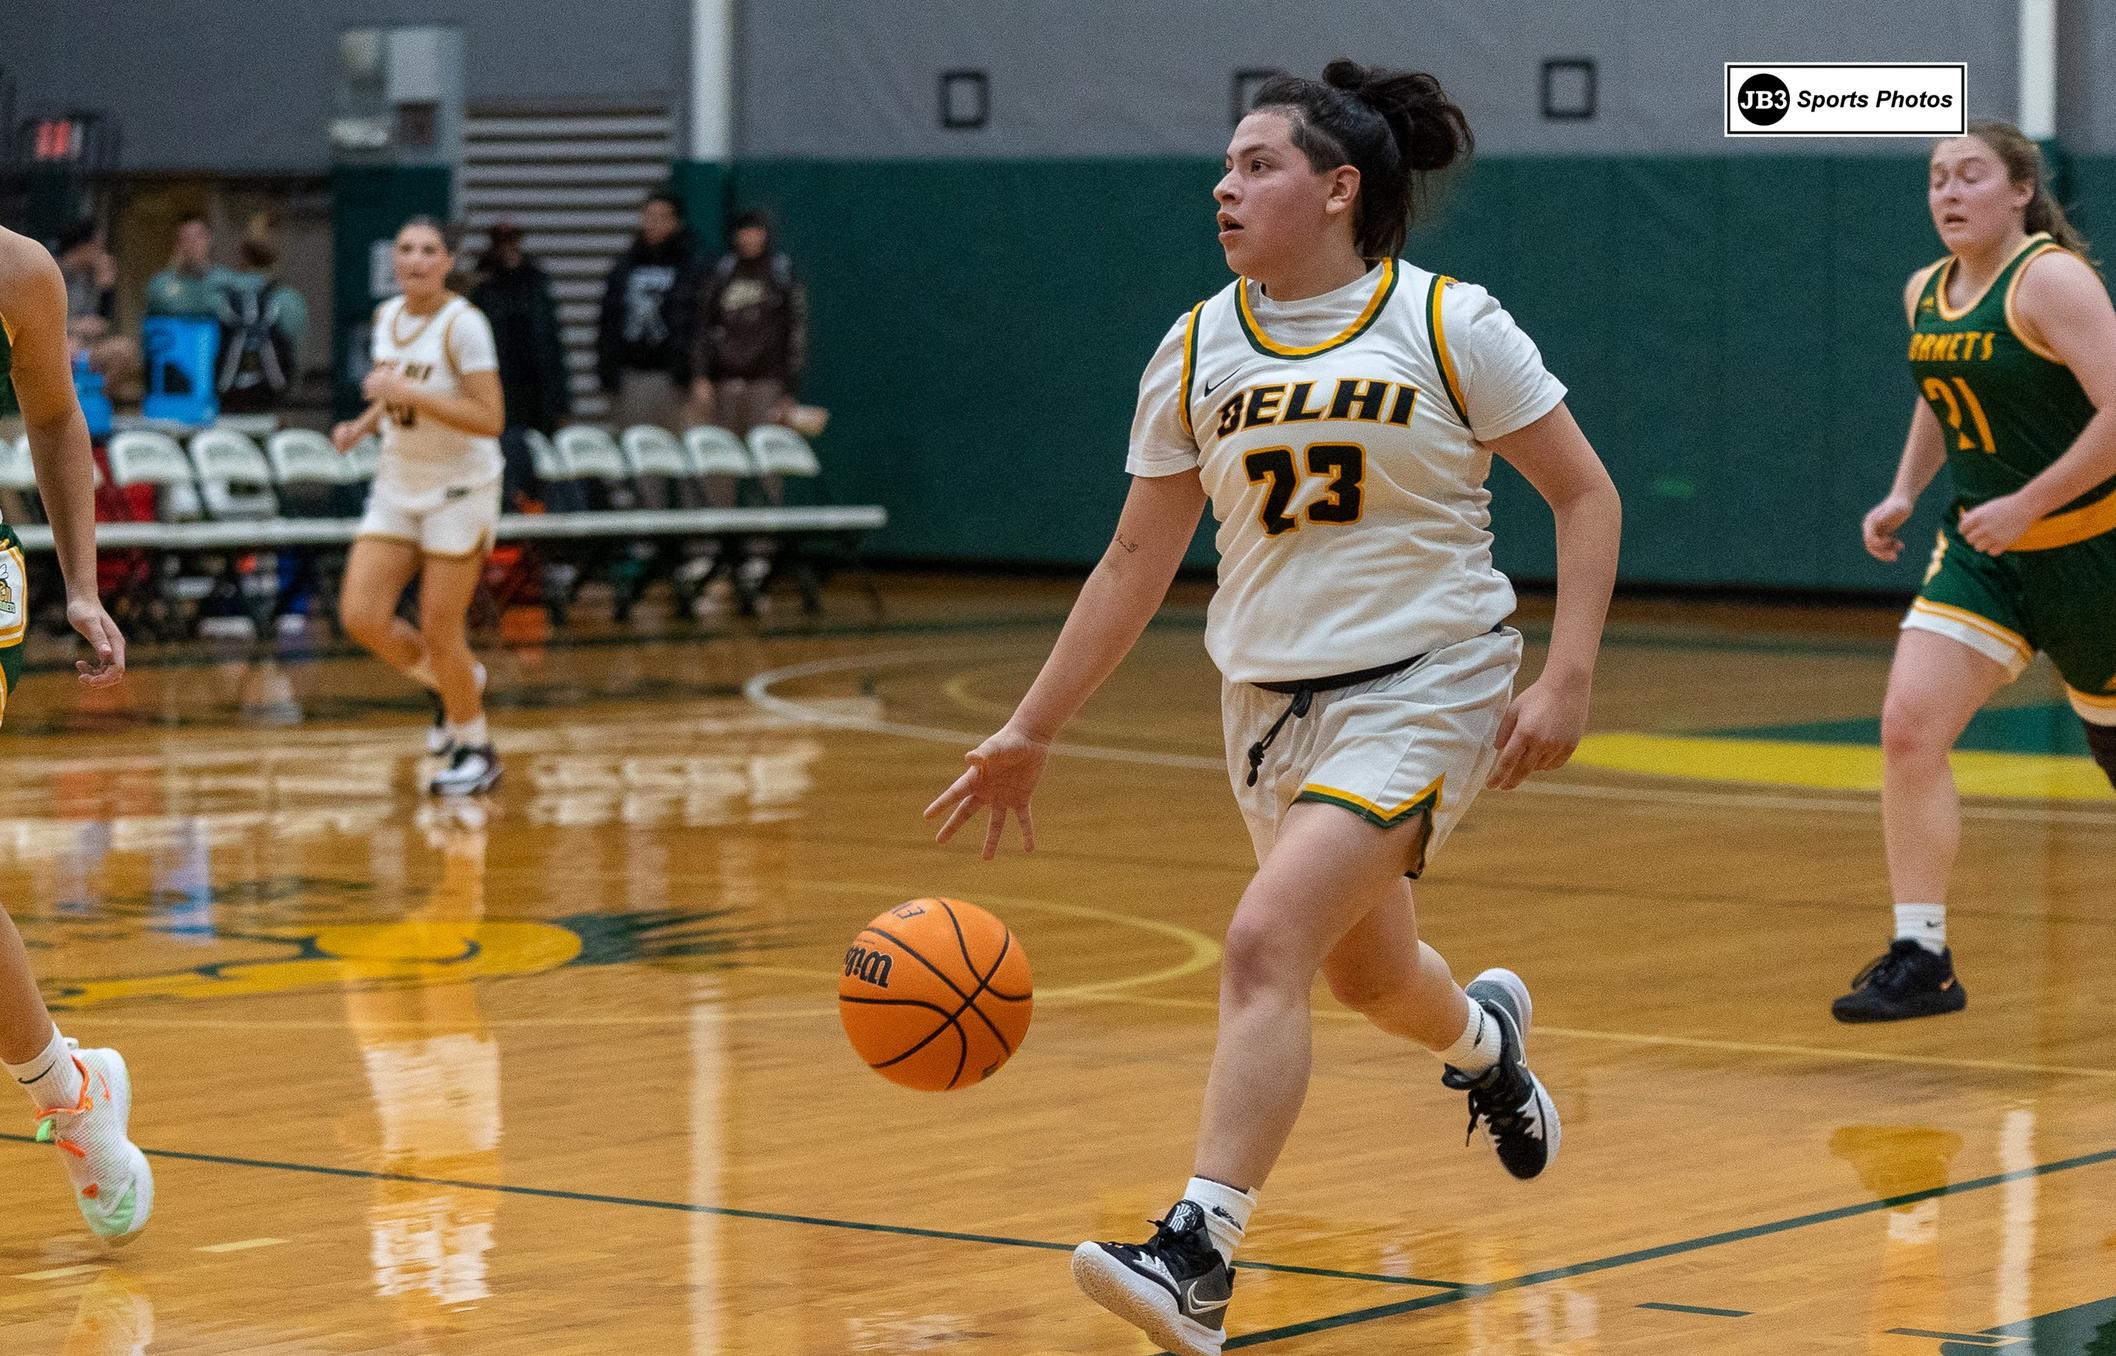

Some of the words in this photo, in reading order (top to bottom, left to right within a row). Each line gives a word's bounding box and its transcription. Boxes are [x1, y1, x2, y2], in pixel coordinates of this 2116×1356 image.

[1215, 377, 1421, 440] DELHI
[1922, 377, 1997, 454] 21
[1242, 441, 1367, 539] 23
